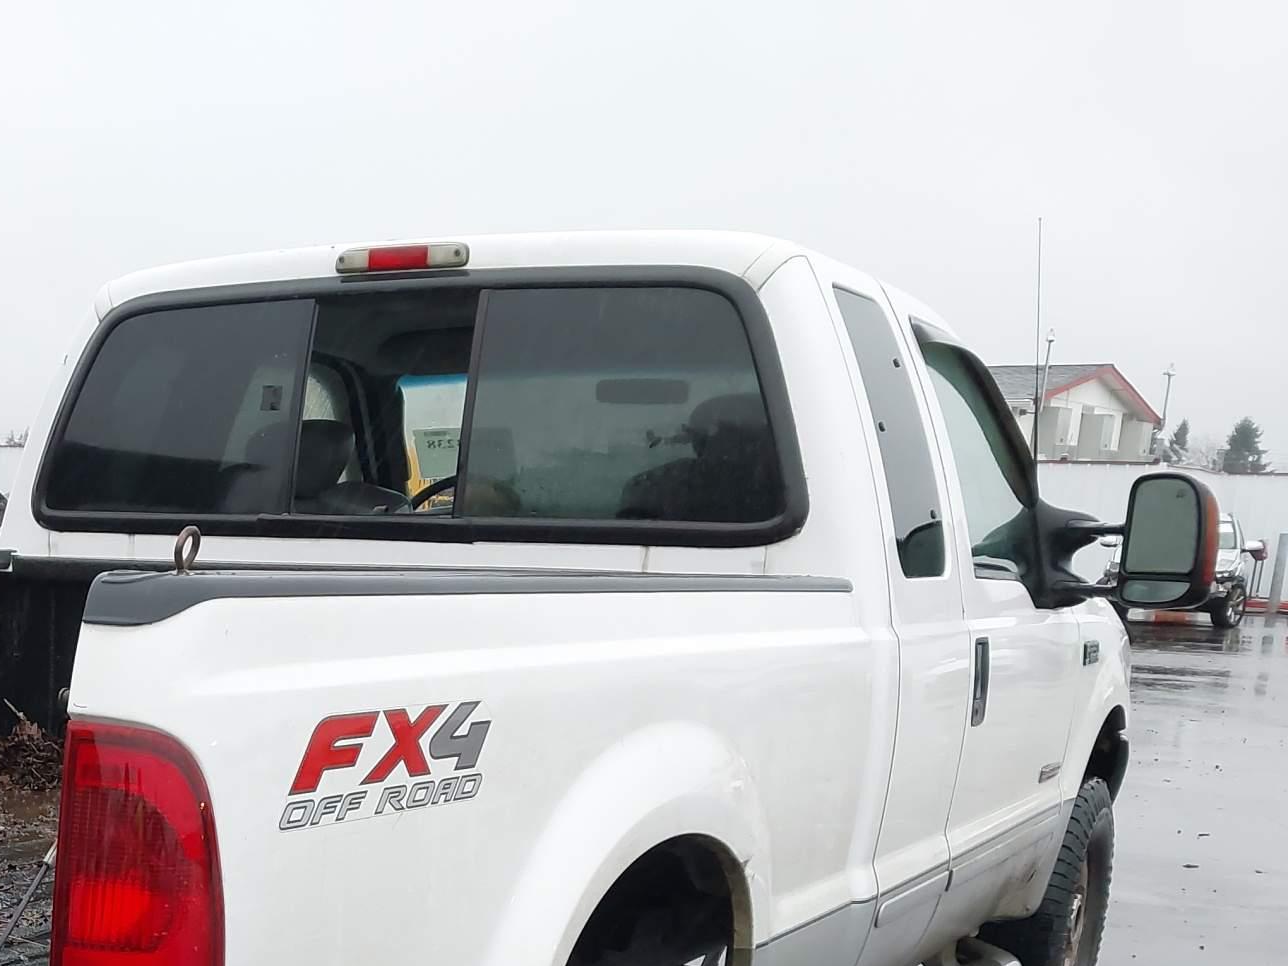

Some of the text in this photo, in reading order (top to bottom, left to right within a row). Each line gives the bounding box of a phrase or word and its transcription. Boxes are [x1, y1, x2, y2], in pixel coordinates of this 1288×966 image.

[288, 700, 492, 796] FX4
[279, 773, 483, 831] OFF ROAD
